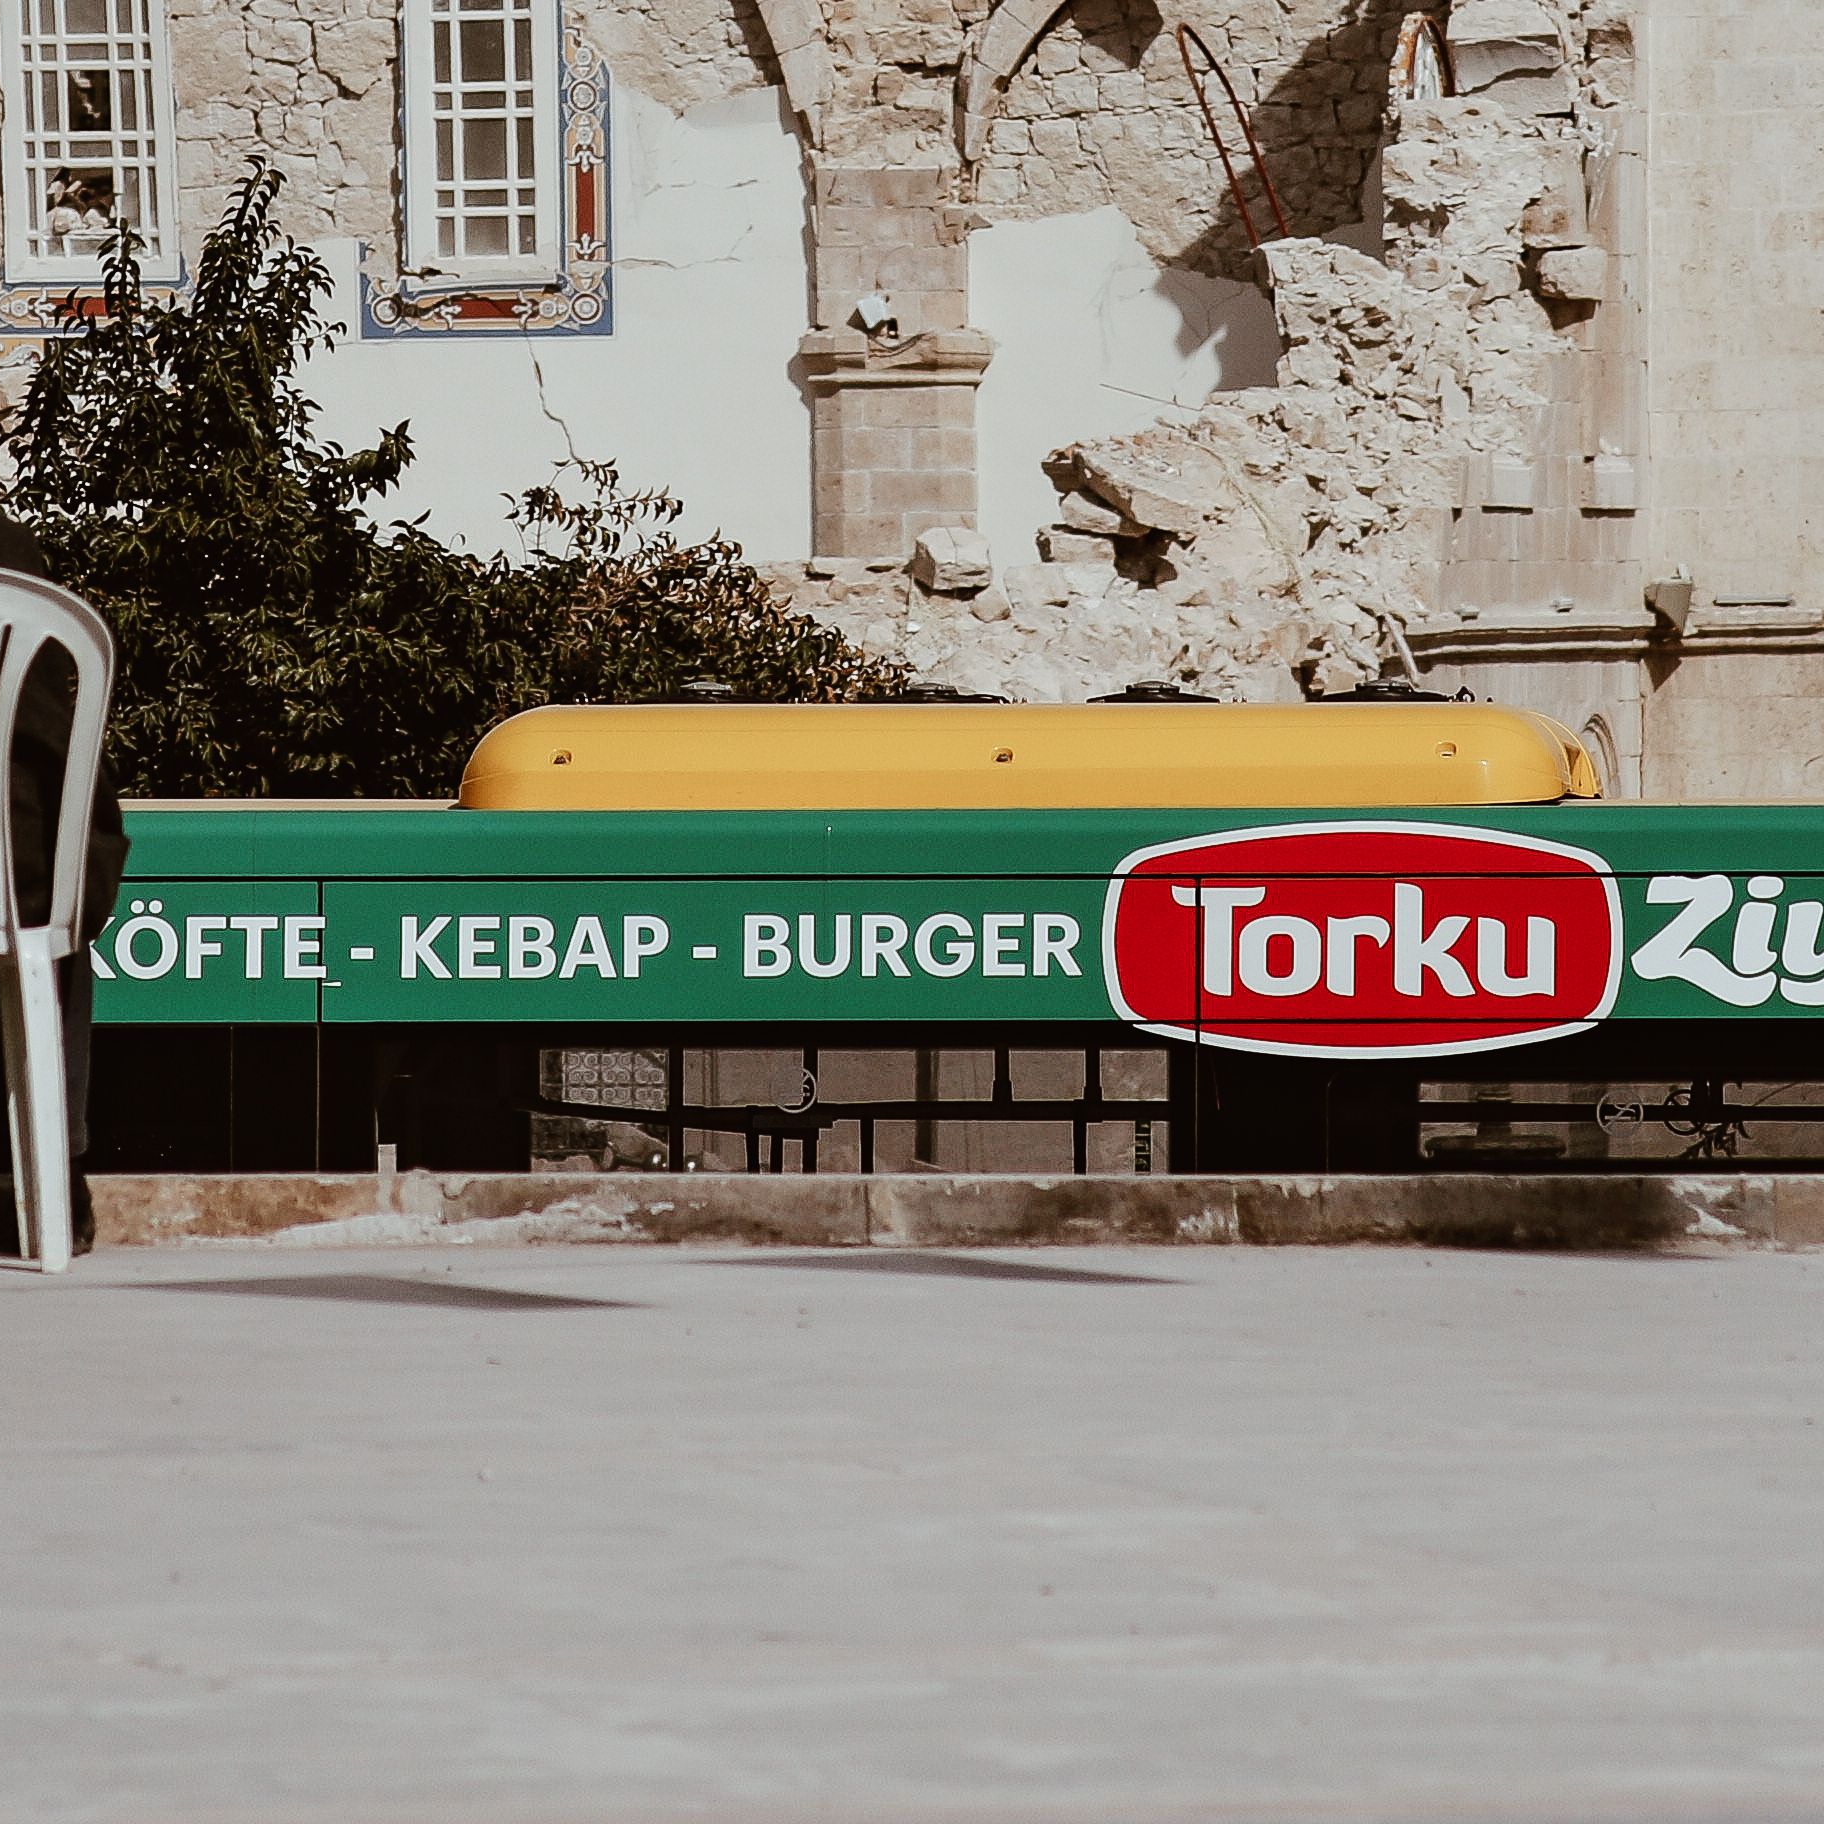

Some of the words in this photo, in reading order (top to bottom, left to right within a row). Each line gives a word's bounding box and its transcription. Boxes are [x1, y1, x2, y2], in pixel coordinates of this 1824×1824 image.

[400, 914, 671, 980] KEBAP
[742, 912, 1084, 980] BURGER
[1171, 882, 1557, 998] Torku
